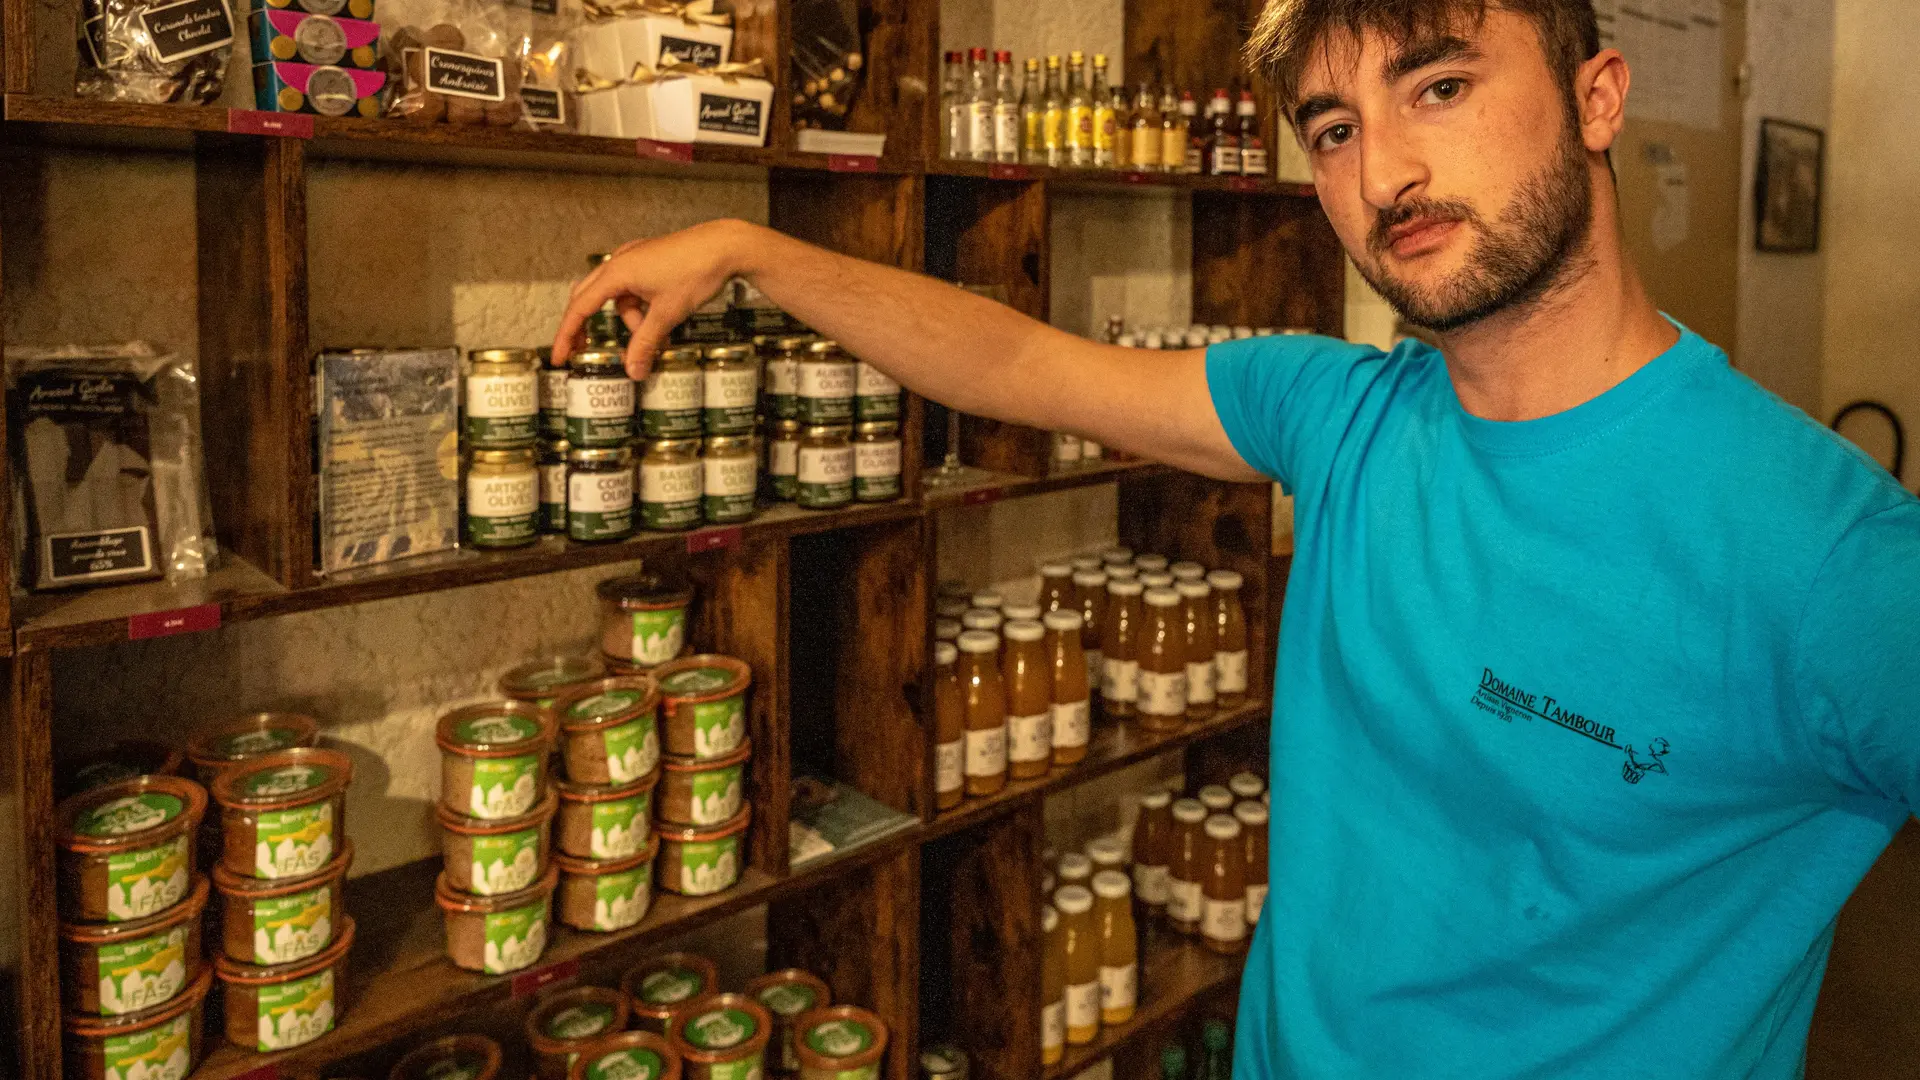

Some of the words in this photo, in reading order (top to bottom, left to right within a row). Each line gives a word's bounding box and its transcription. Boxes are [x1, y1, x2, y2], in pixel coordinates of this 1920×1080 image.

[1470, 695, 1496, 714] Depuis
[1497, 710, 1513, 723] 1920
[1475, 689, 1500, 706] Artisan
[1501, 700, 1533, 722] Vigneron
